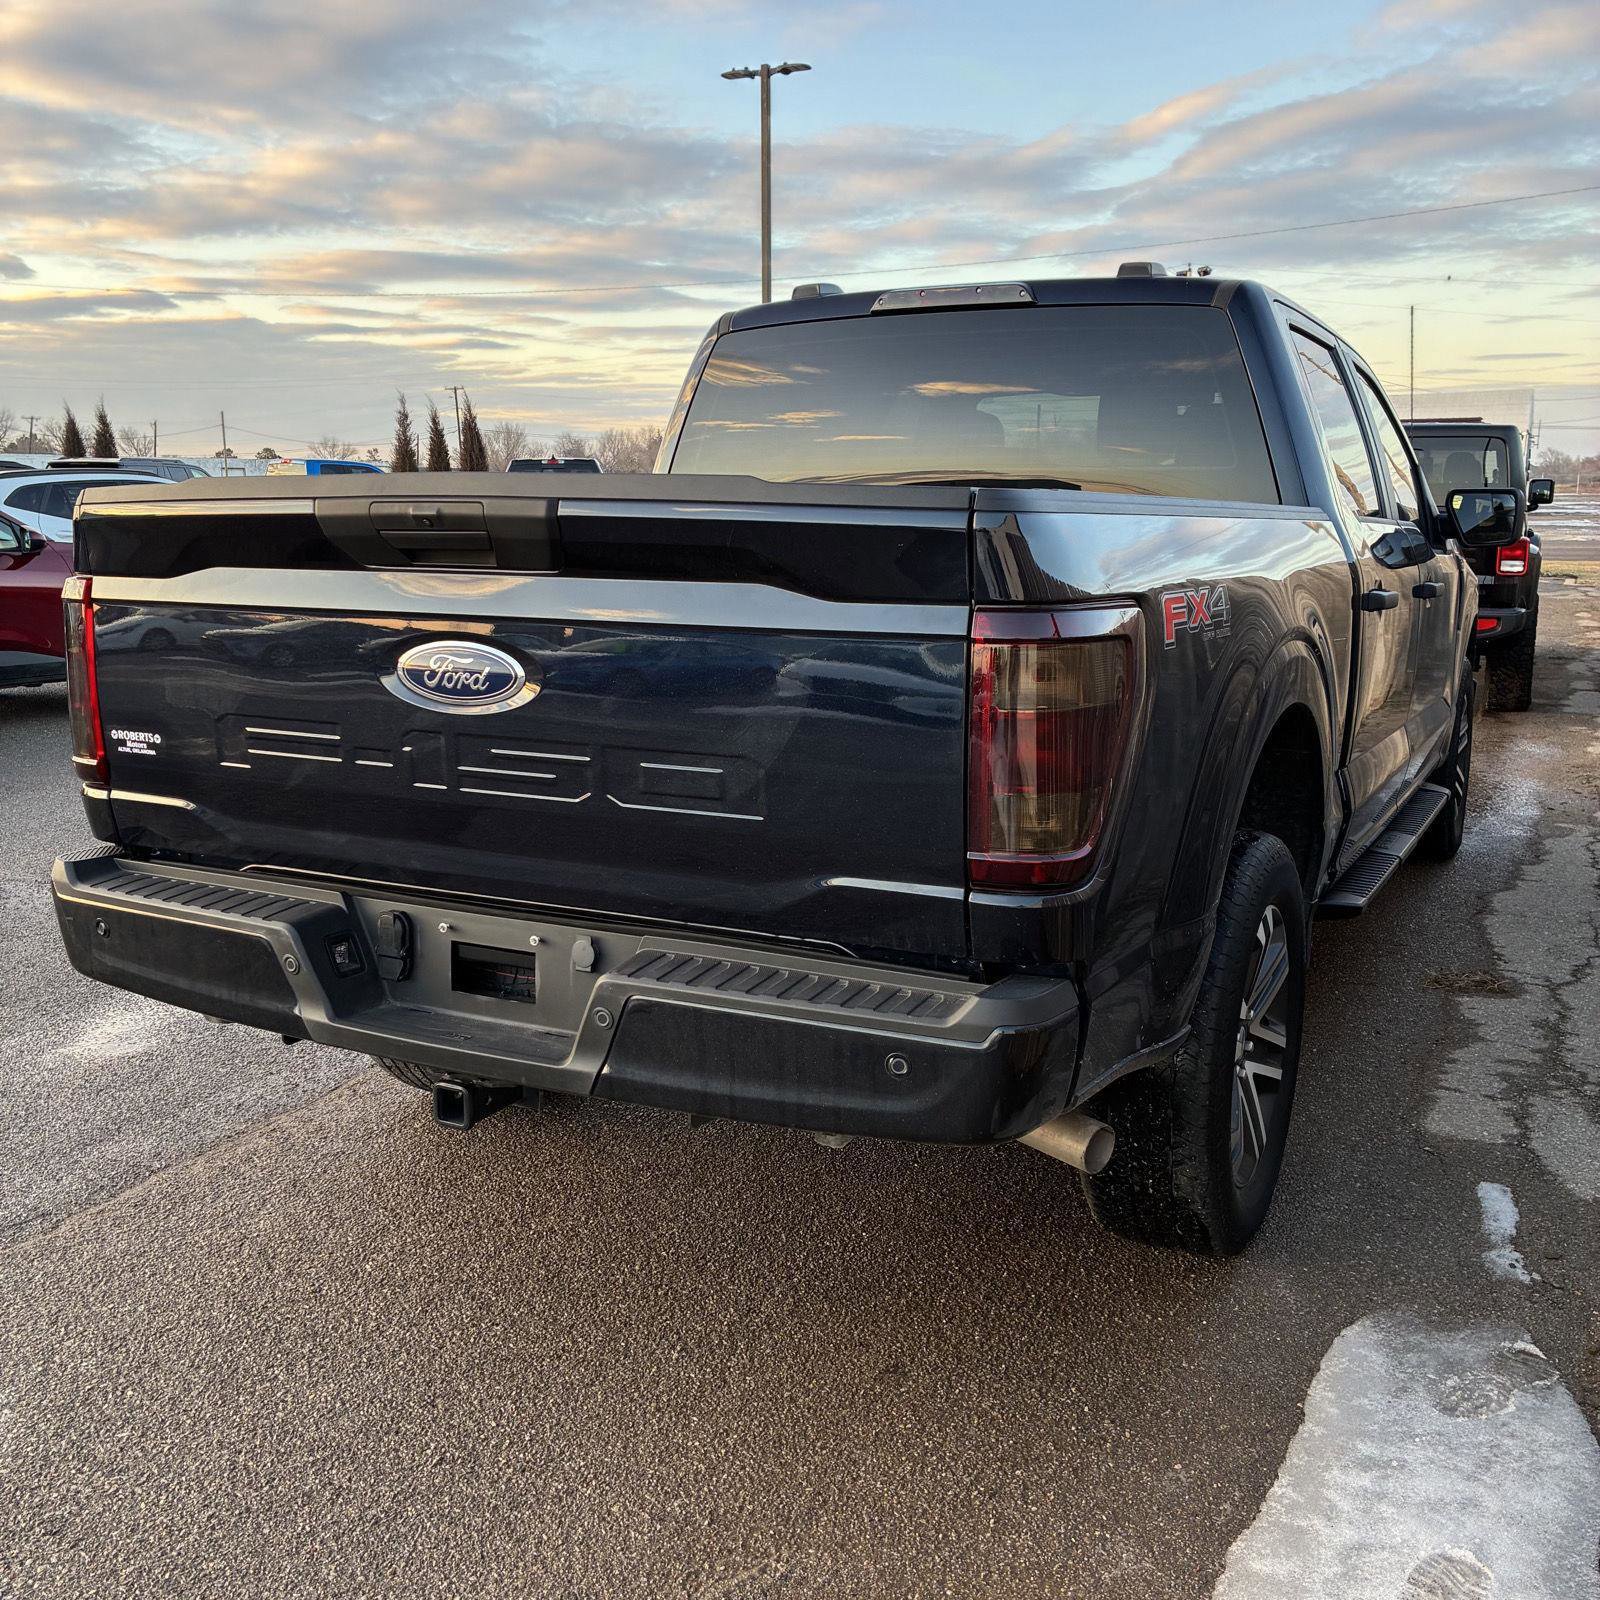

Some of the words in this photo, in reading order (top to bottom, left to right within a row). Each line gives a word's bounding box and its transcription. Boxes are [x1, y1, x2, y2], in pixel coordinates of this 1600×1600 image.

[1161, 584, 1231, 649] FX4
[423, 654, 490, 691] Ford
[118, 730, 153, 743] ROBERTS
[216, 712, 766, 821] F-150
